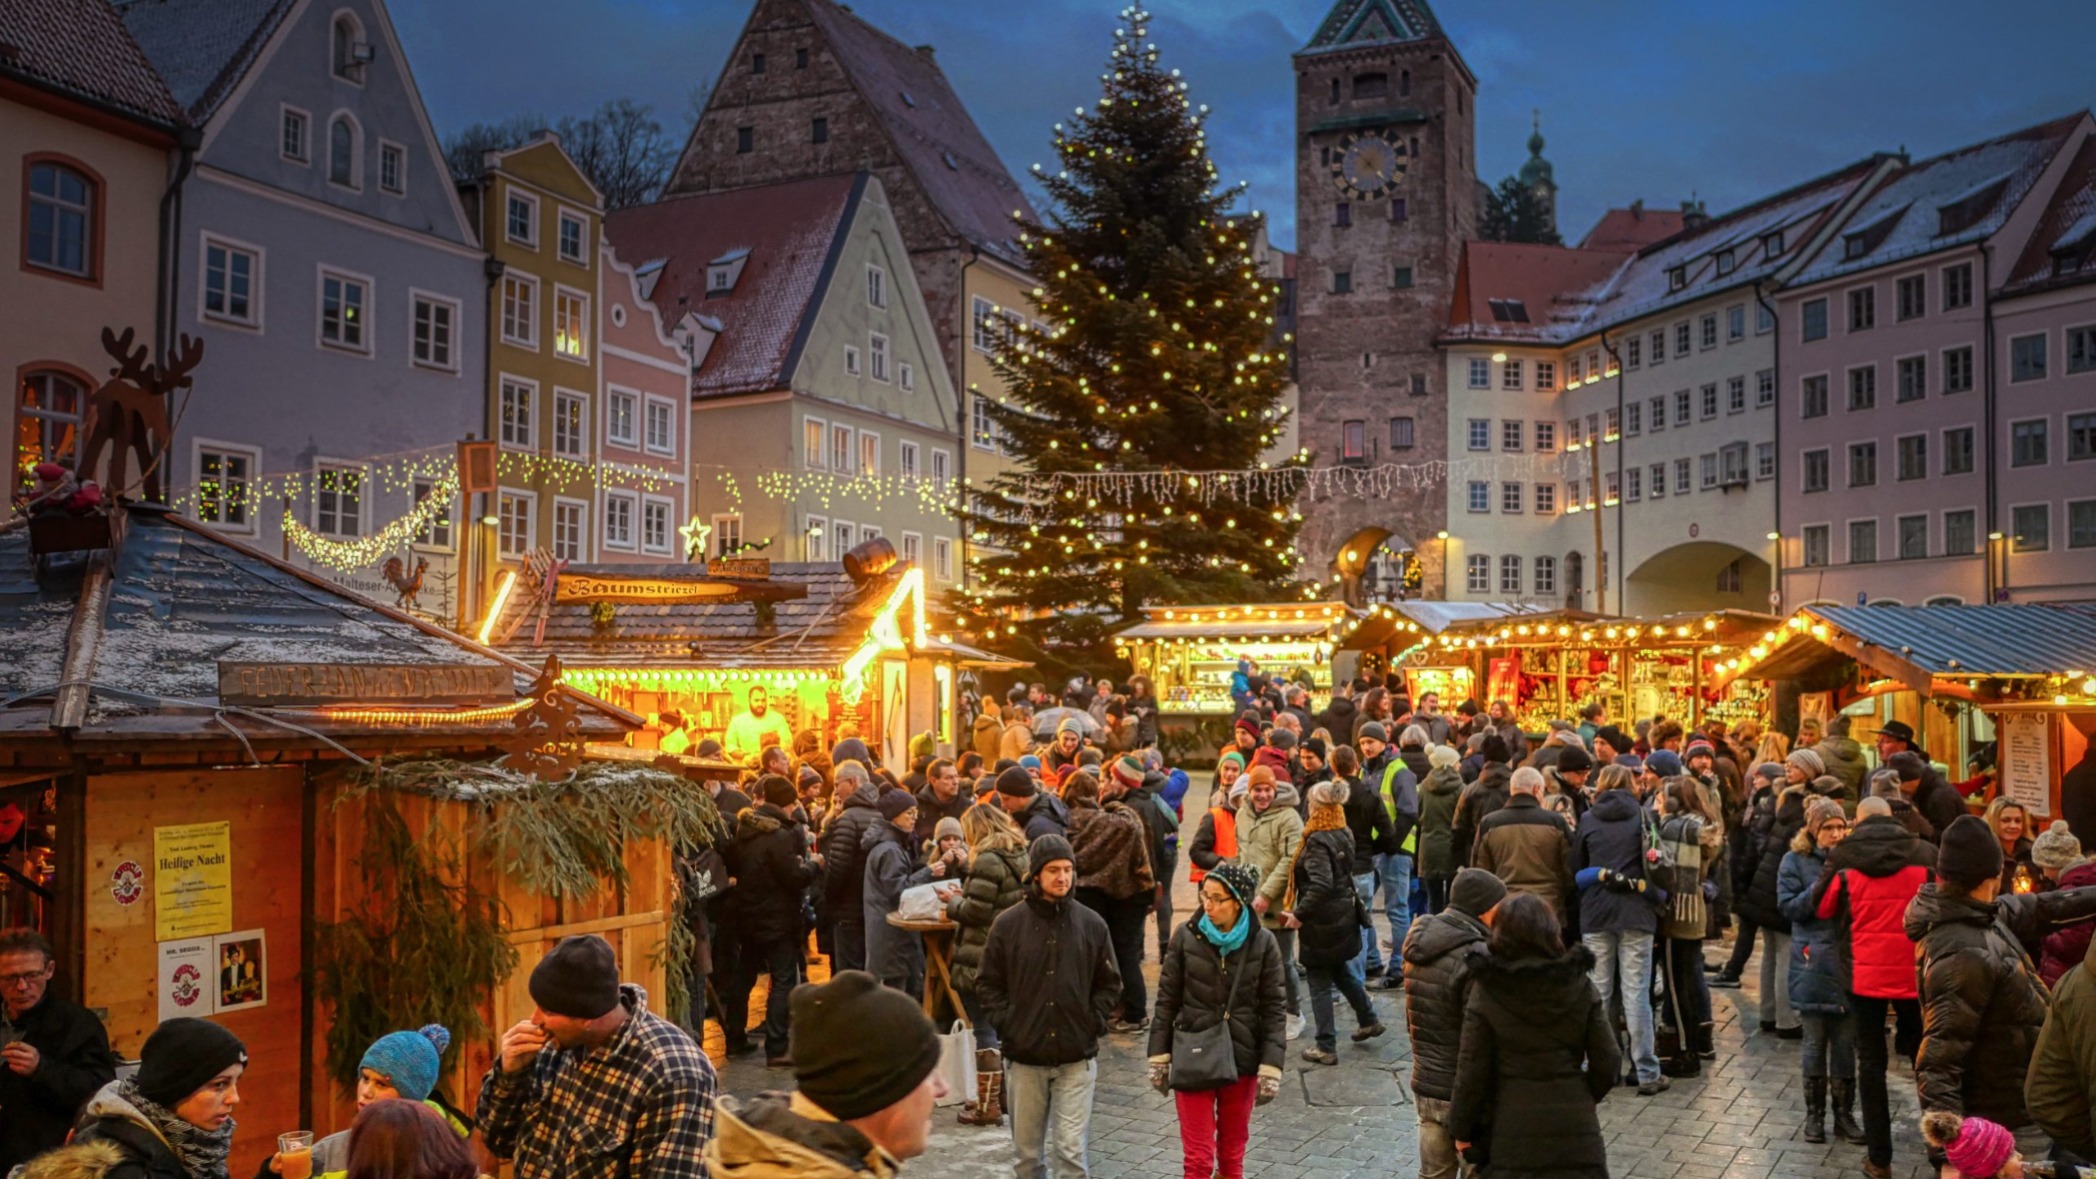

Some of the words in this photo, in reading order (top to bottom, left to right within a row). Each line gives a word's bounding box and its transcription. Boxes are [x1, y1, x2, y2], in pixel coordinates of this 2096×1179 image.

[333, 576, 436, 595] Malteser-Ake
[568, 578, 698, 596] Baumstriezel
[160, 856, 194, 870] Heilige
[197, 853, 225, 866] Nacht
